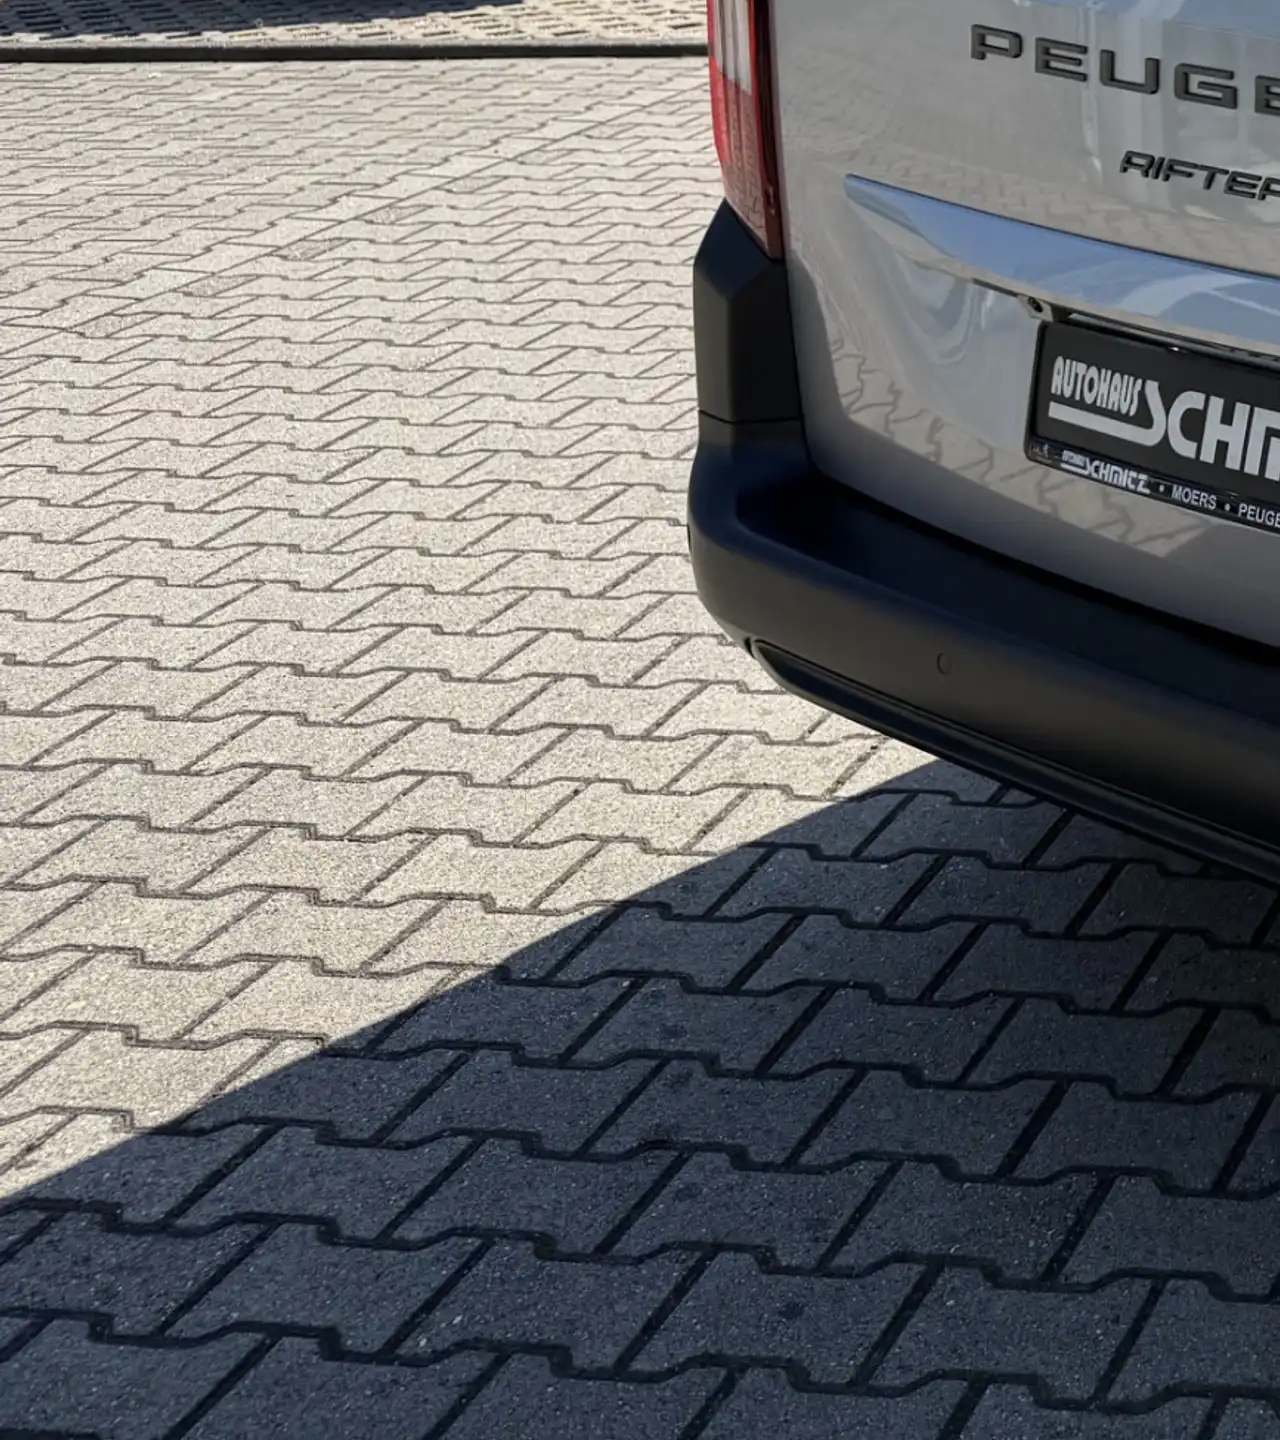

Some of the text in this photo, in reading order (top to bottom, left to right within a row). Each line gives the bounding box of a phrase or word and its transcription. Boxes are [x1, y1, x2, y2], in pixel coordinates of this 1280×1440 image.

[1050, 355, 1143, 417] AUTOHAUS
[1061, 456, 1151, 495] SCHMITZ
[1171, 484, 1217, 510] MOERS
